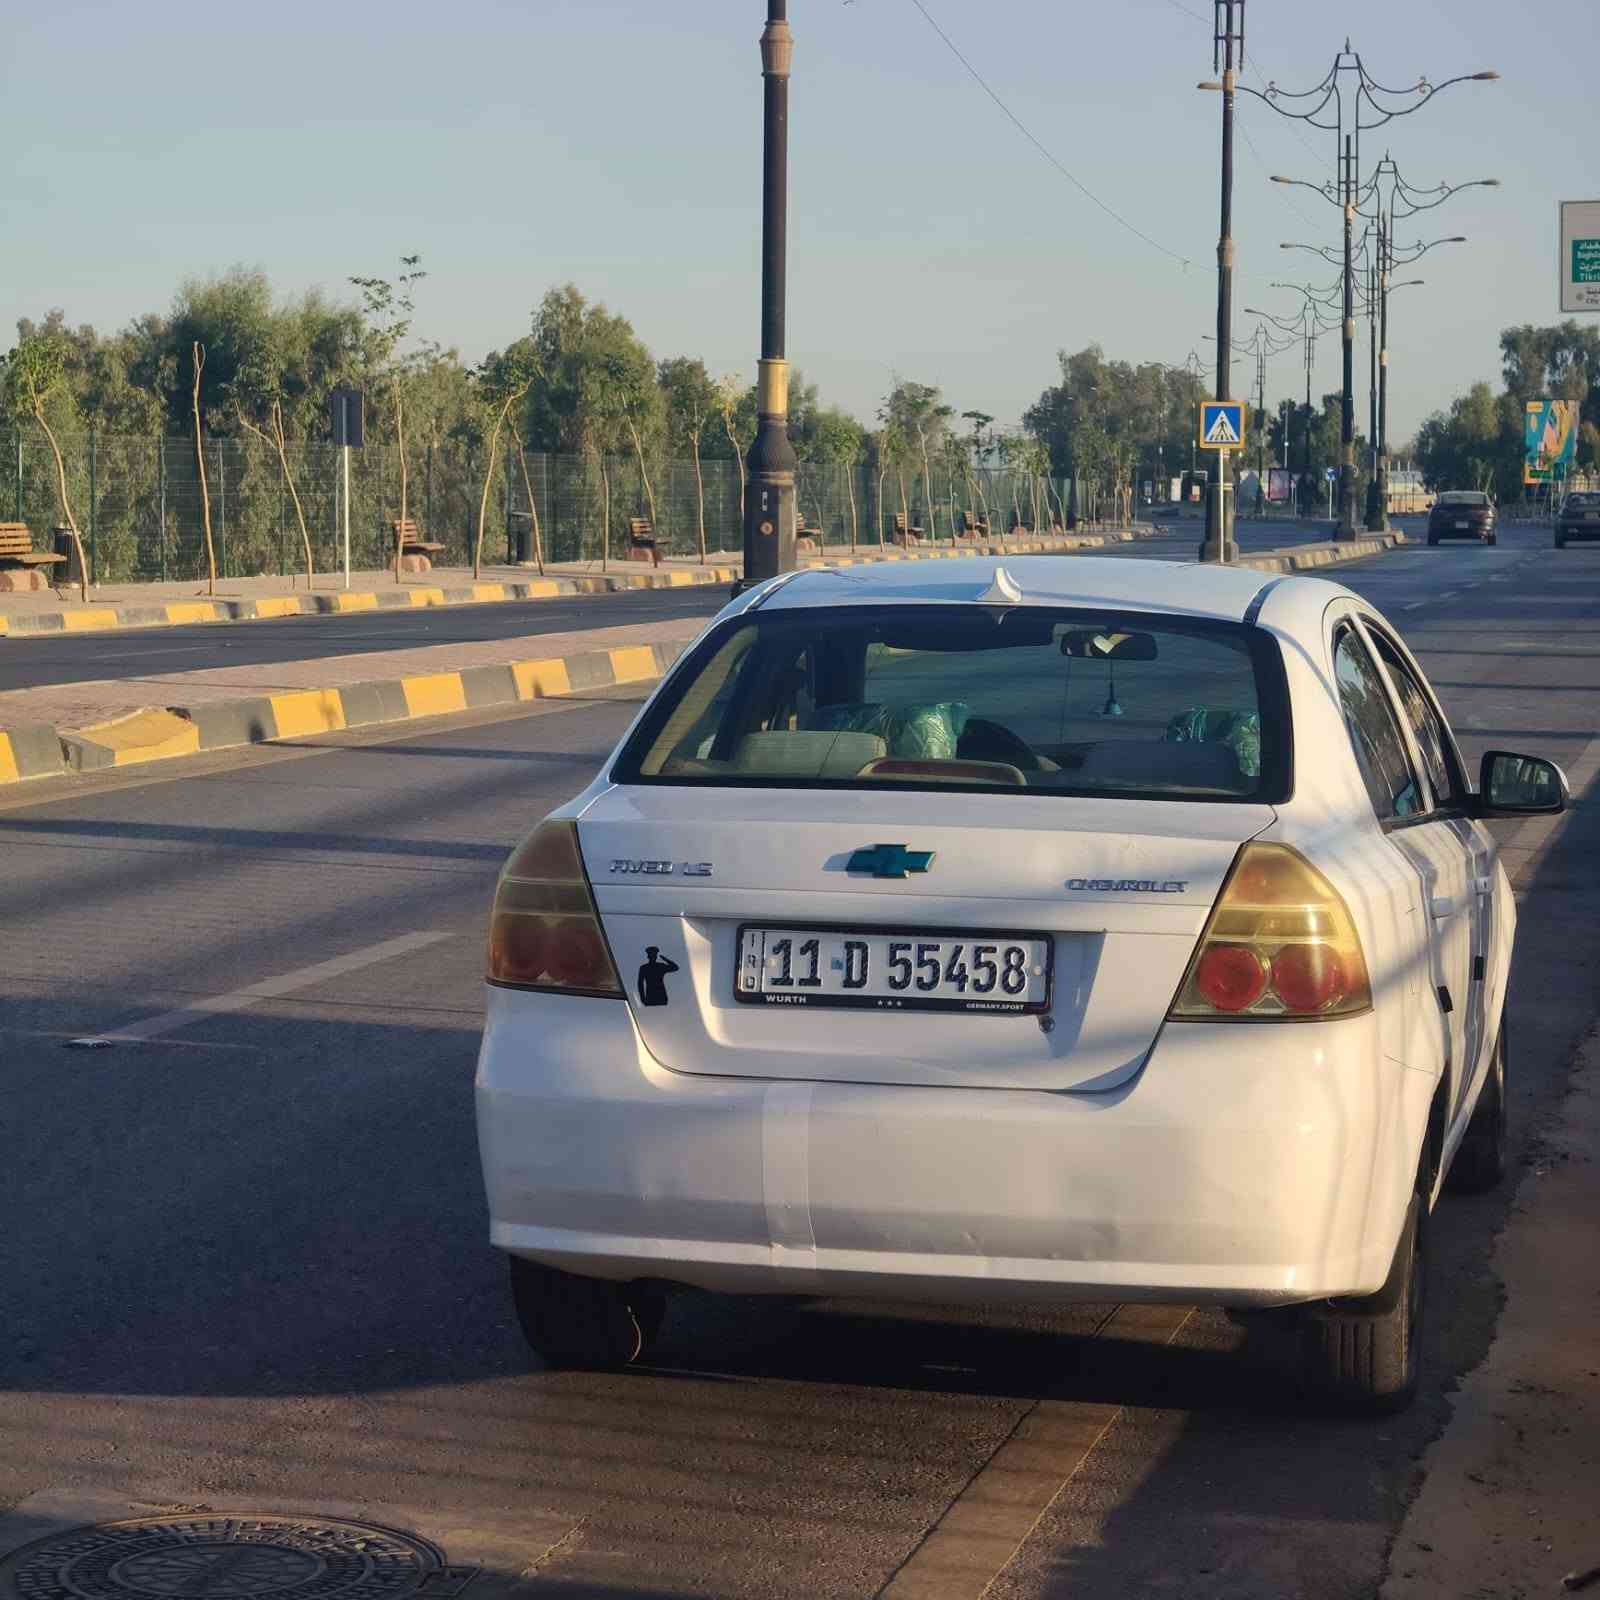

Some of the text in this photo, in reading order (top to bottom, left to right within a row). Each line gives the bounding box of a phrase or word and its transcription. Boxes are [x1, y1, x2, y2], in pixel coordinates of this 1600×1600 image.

[609, 859, 713, 876] AVEO LS
[1064, 878, 1189, 893] CHEVROLET
[770, 938, 1027, 995] 11 D 55458
